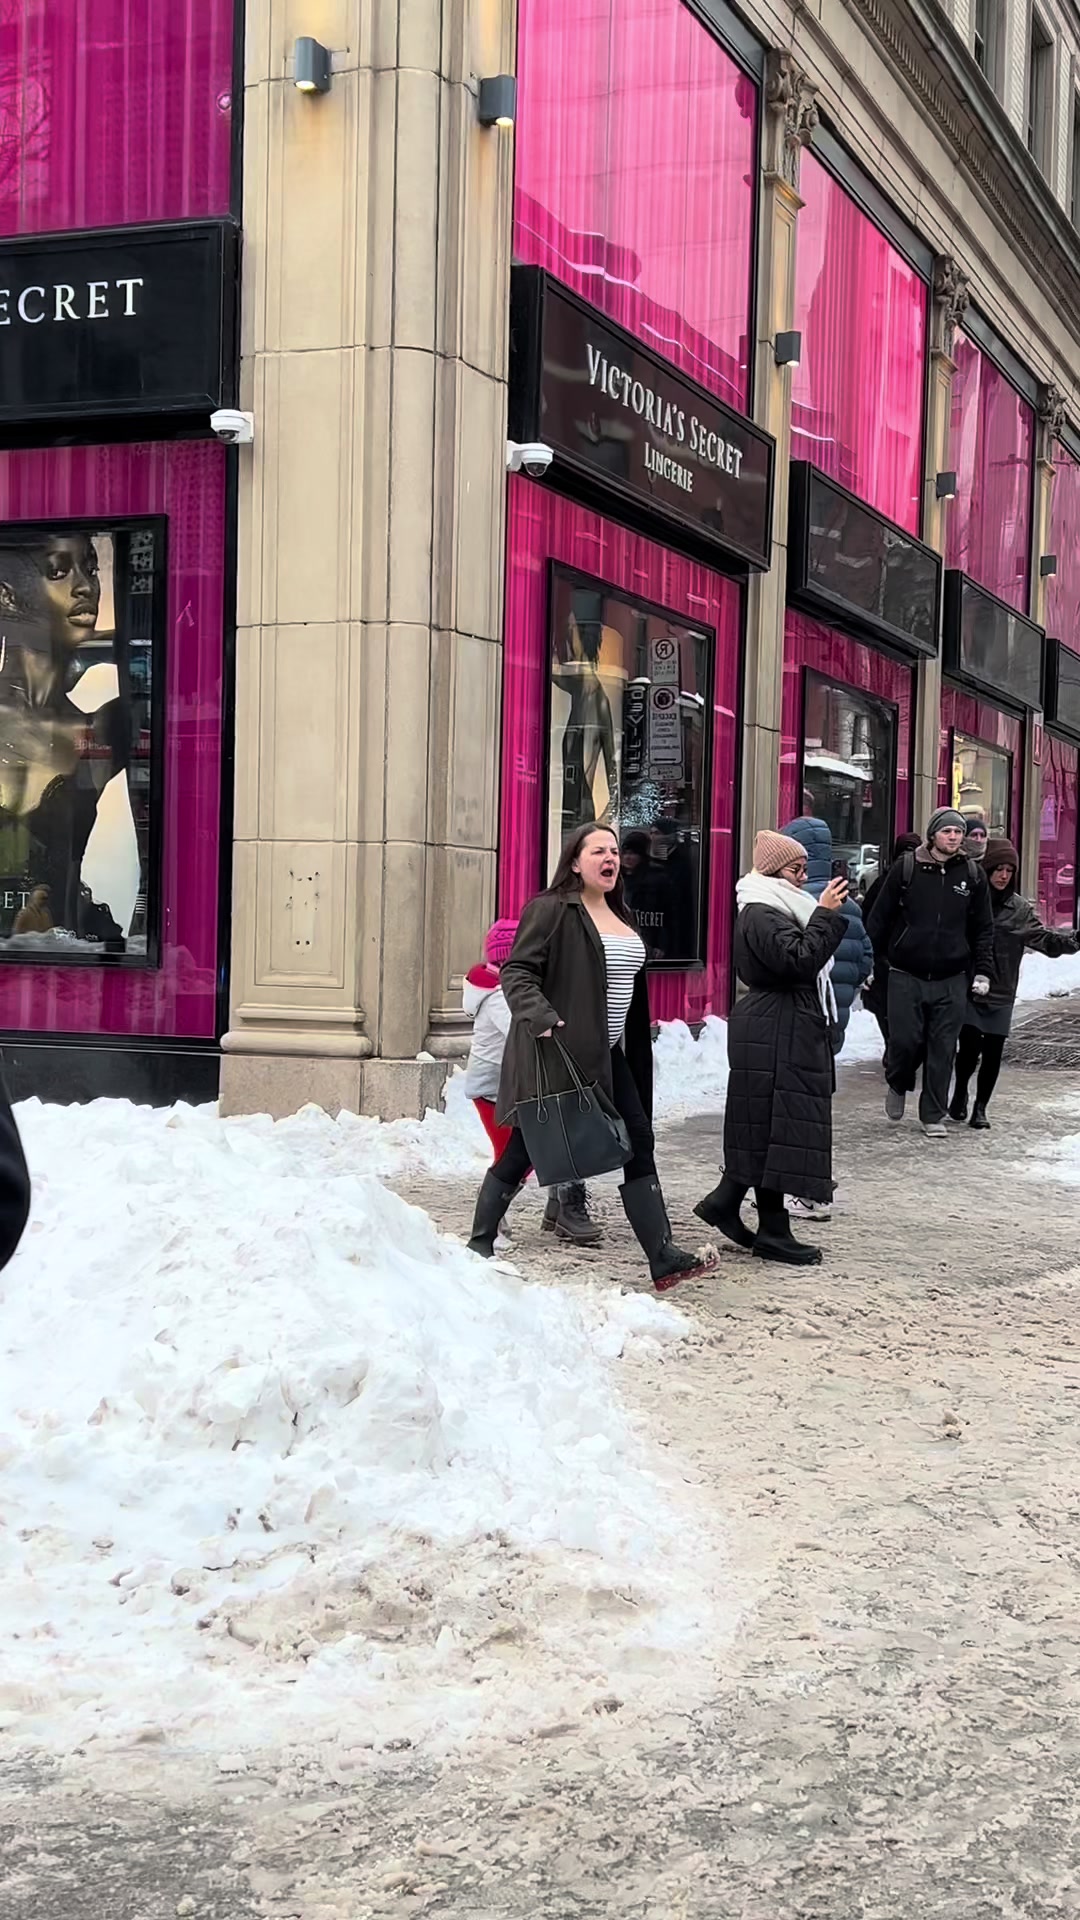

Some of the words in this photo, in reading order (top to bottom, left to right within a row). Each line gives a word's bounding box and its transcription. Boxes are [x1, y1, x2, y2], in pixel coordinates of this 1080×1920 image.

[586, 343, 685, 442] VICTORIA'S
[690, 415, 743, 480] SECRET
[644, 441, 694, 493] LINGERIE
